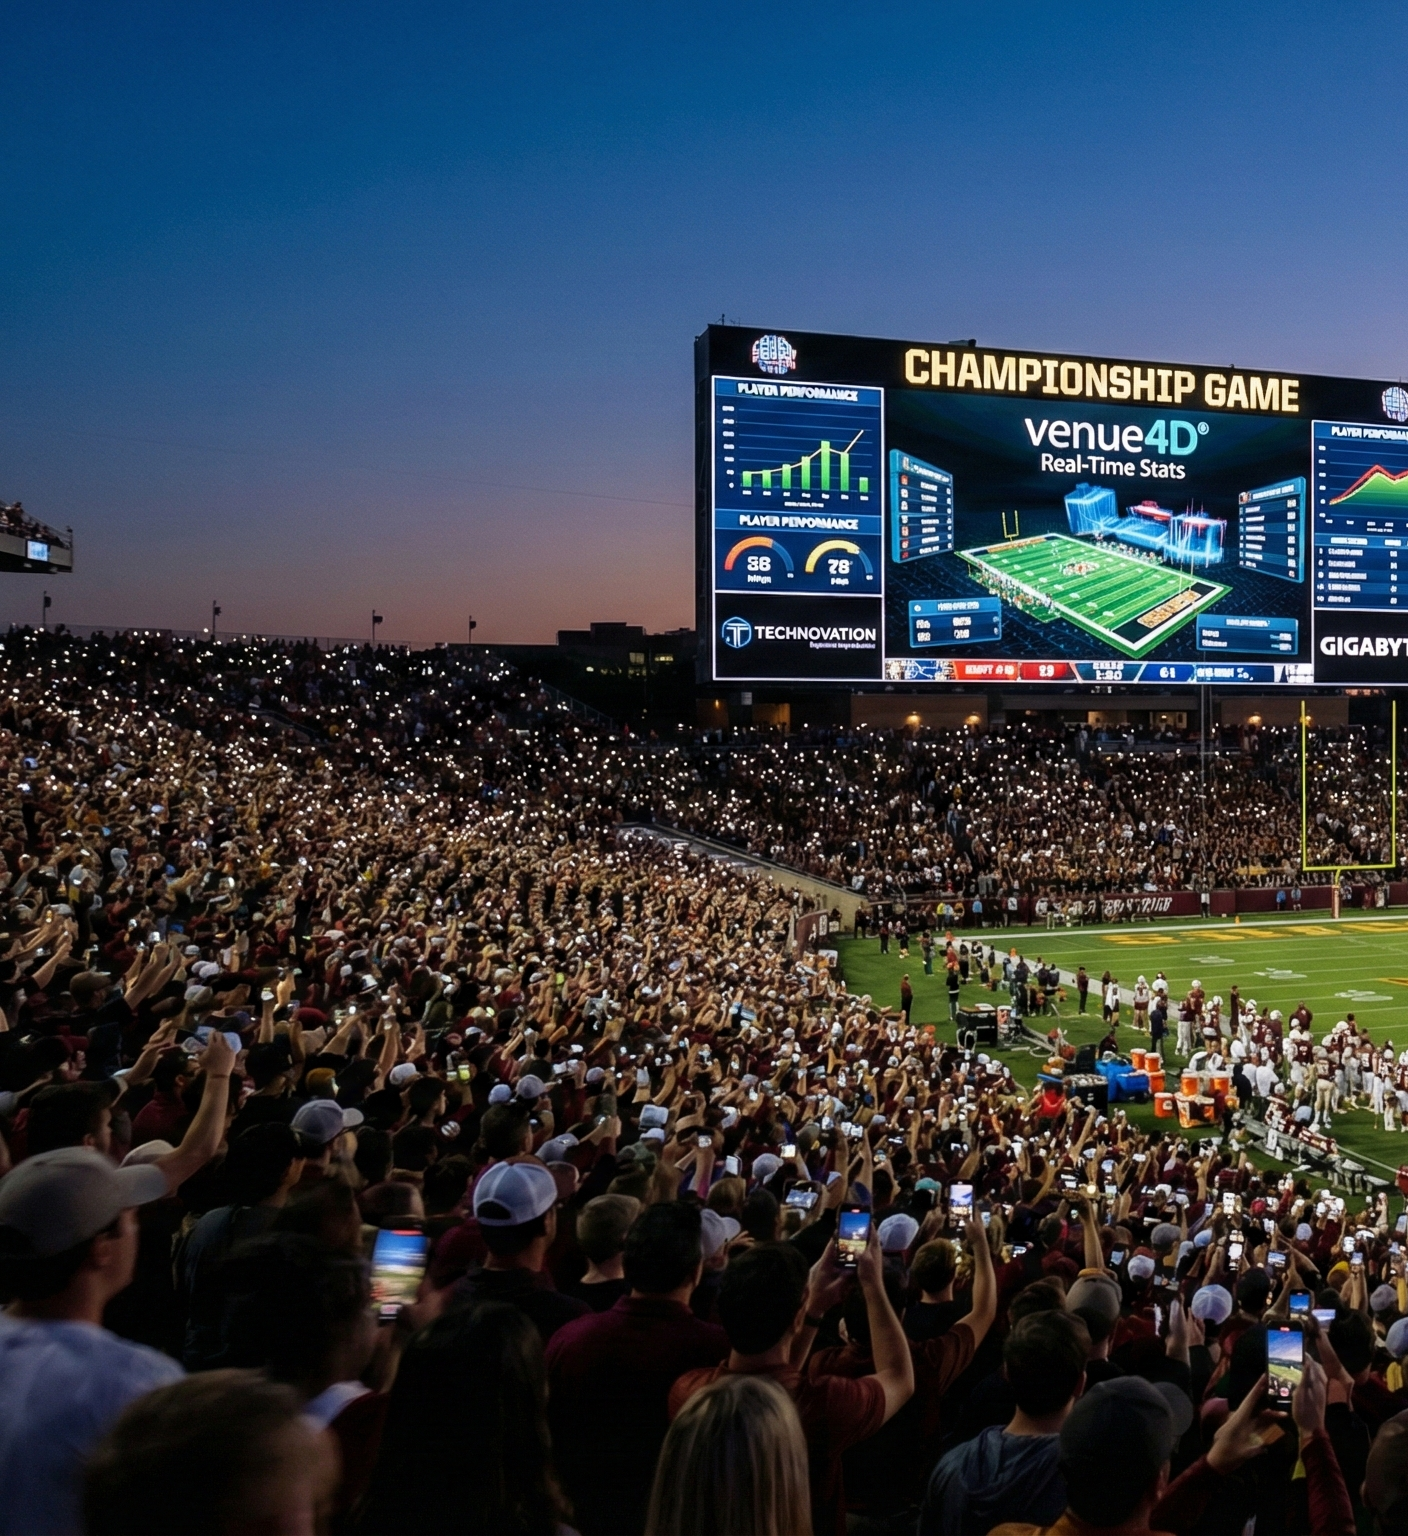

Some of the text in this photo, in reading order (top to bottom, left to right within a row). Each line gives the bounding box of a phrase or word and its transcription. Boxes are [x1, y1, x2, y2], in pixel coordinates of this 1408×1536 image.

[905, 348, 1300, 412] CHAMPIONSHIP GAME
[1041, 452, 1186, 480] Real-Time Stats
[754, 625, 877, 641] TECHNOVATION
